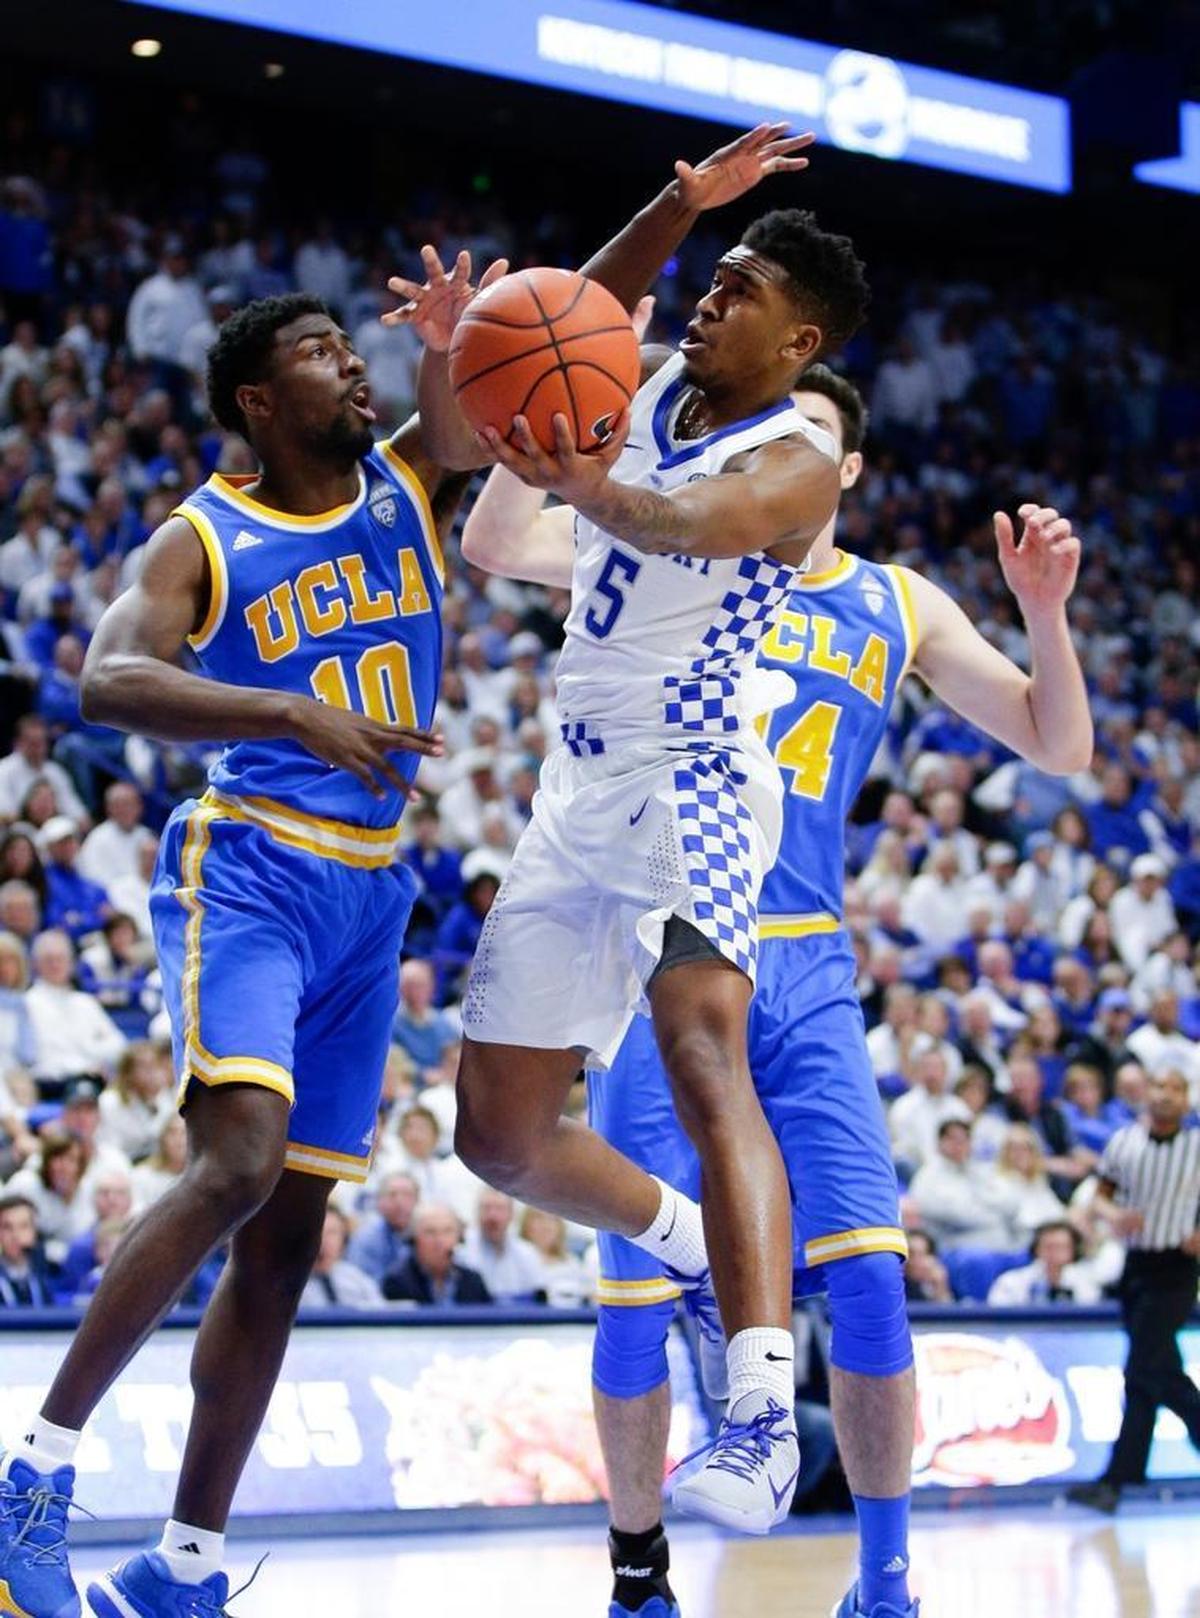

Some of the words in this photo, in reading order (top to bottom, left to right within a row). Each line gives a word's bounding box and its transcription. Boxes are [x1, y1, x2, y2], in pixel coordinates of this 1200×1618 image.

[244, 547, 432, 664] UCLA
[584, 547, 641, 640] 5
[309, 640, 418, 730] 10
[760, 609, 888, 708] CLA
[754, 700, 843, 802] 4
